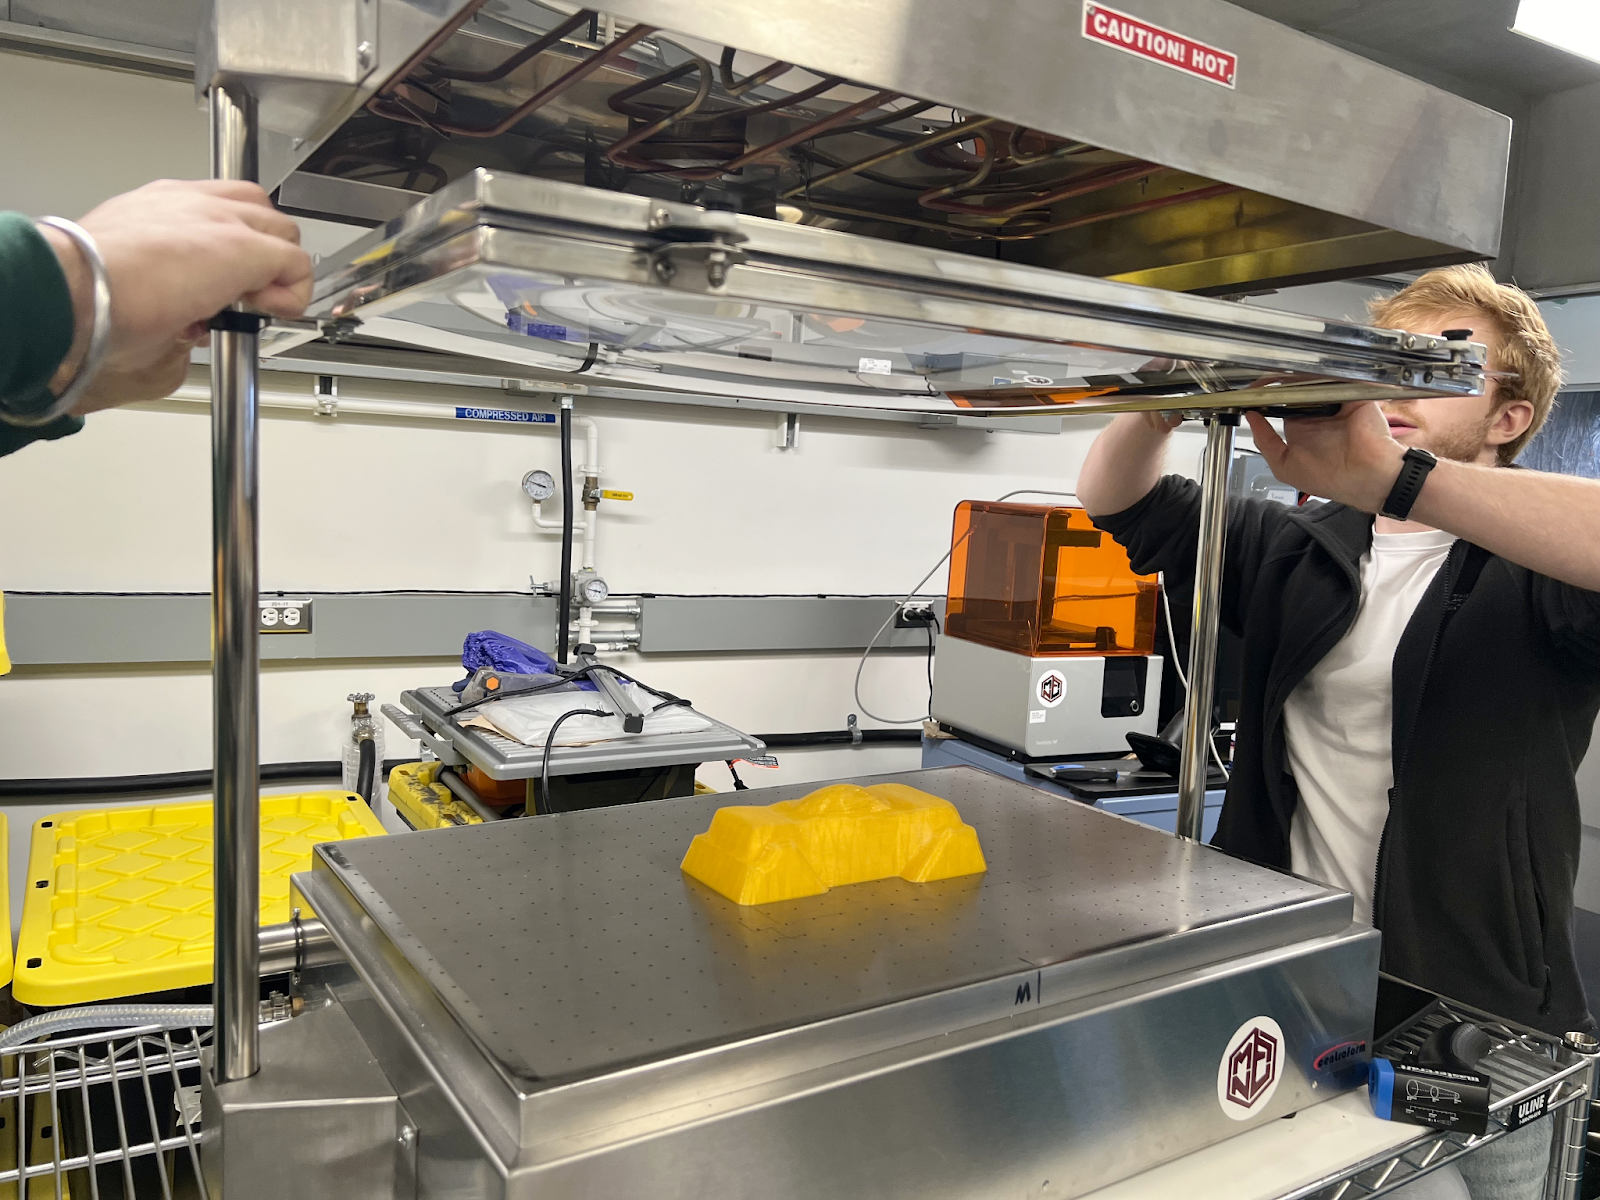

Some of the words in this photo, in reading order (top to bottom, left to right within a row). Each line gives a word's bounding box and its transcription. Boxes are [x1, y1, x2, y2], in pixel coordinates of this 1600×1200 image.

[1093, 12, 1186, 63] CAUTION!
[1191, 47, 1229, 77] HOT
[464, 408, 529, 421] COMPRESSED
[531, 413, 547, 422] AIR
[1518, 1093, 1546, 1119] ULINE
